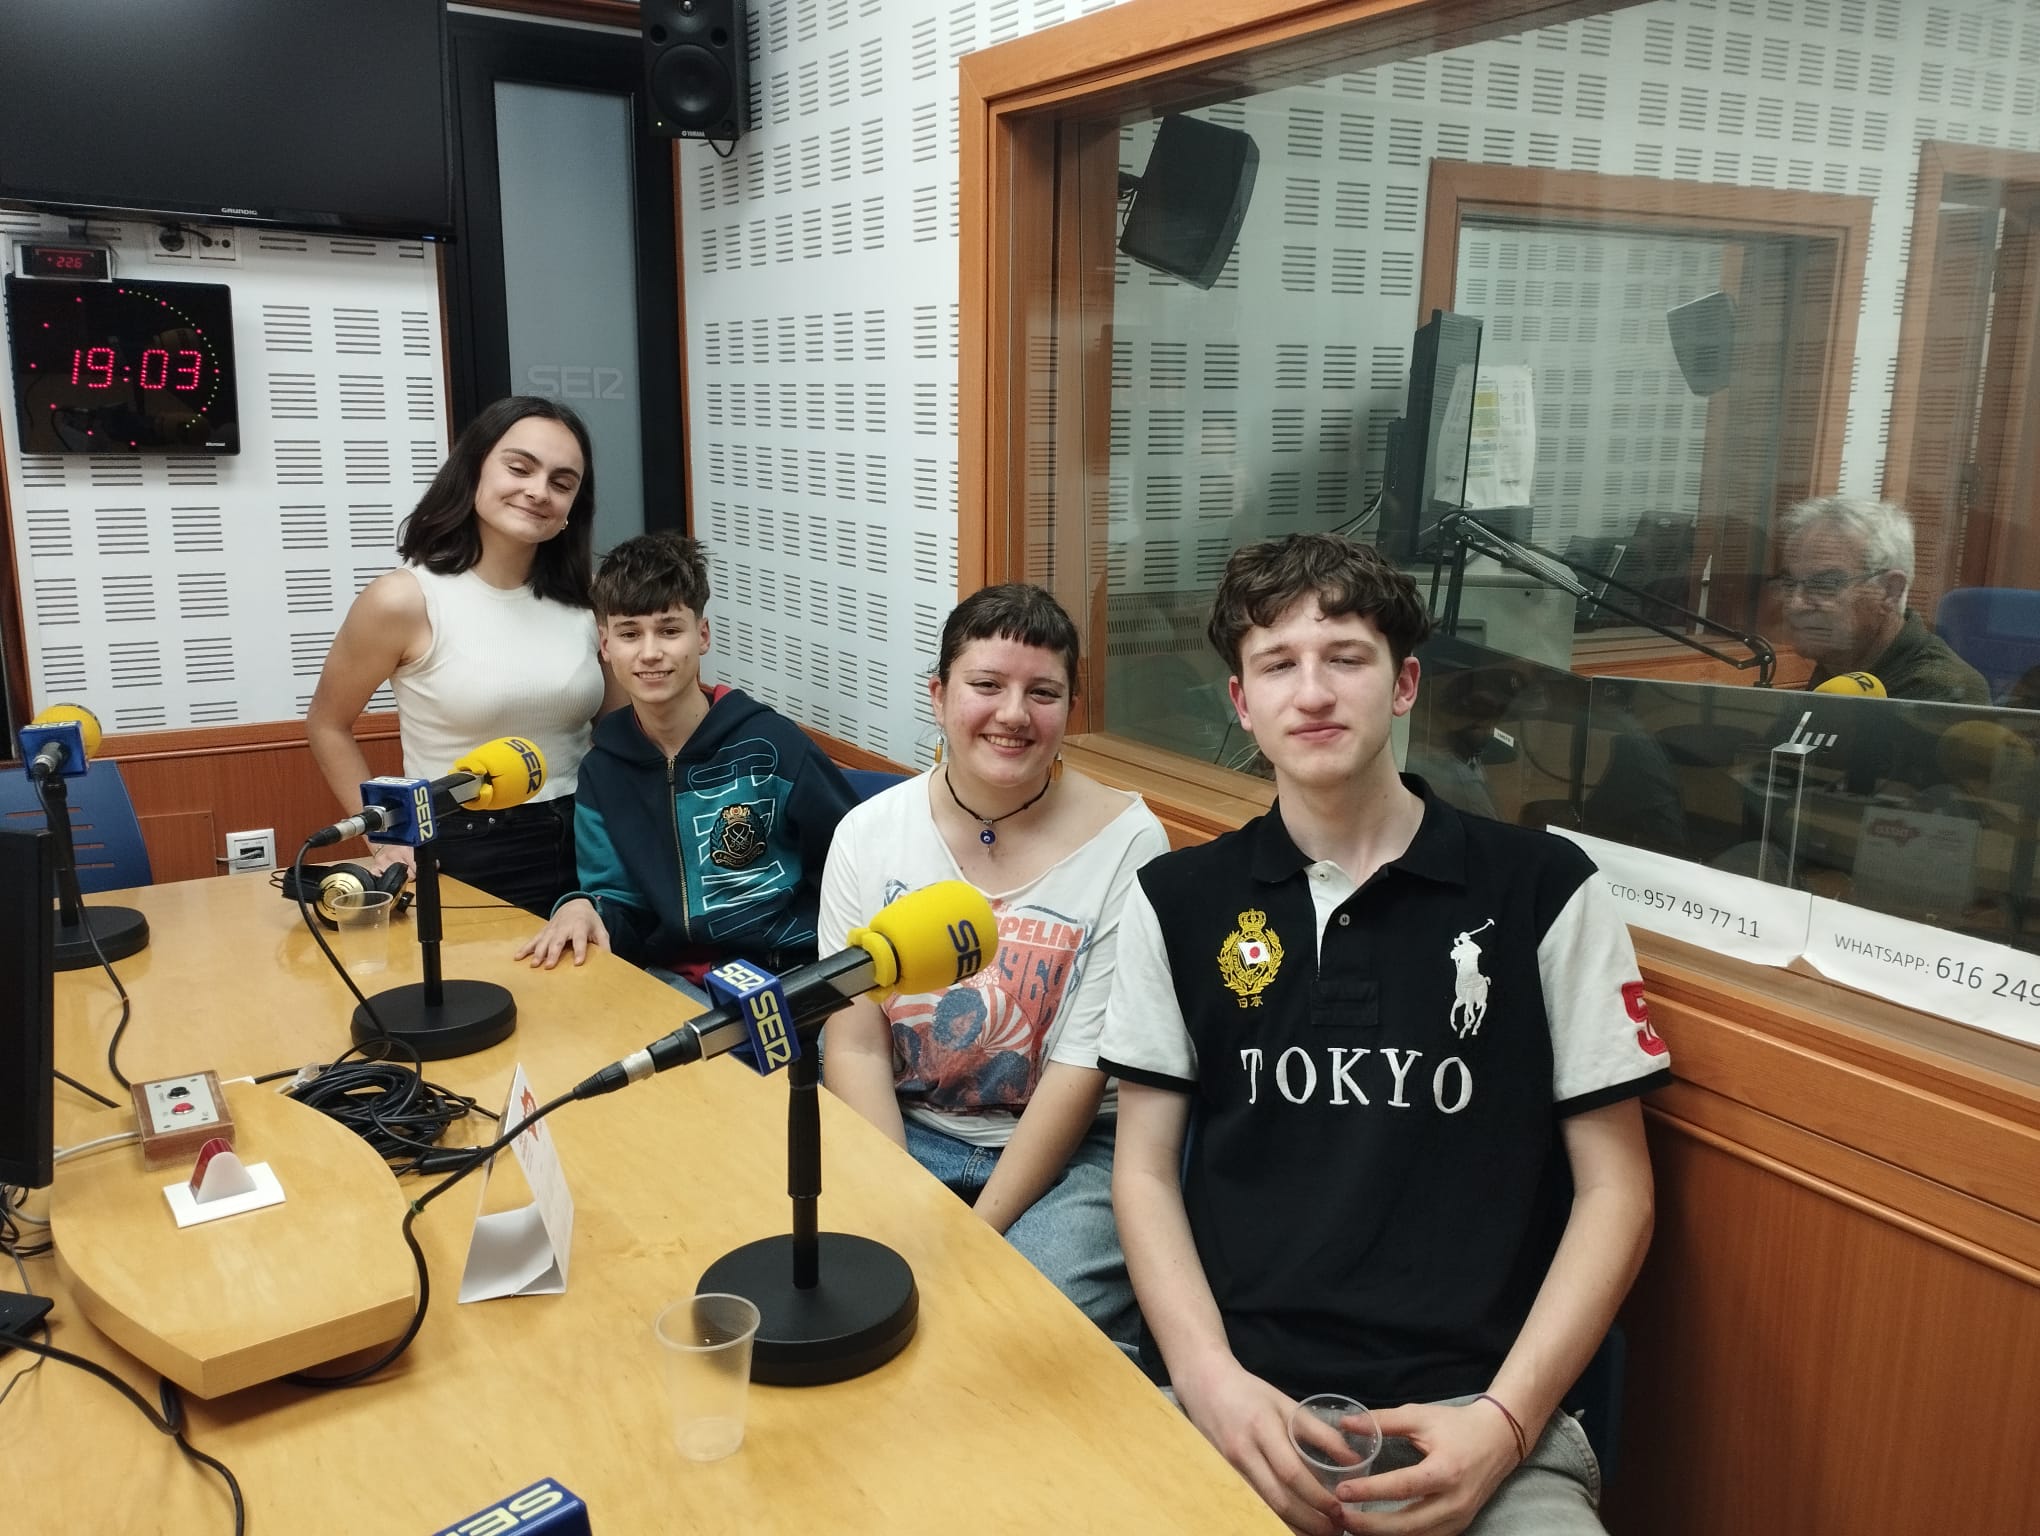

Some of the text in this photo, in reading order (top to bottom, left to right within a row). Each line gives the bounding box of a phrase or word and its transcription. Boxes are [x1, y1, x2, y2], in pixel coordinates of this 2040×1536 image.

[72, 347, 202, 390] 19:03
[527, 364, 625, 400] SER
[505, 739, 543, 795] SER
[413, 786, 434, 843] SER
[998, 915, 1084, 950] PELIN
[1644, 889, 1676, 911] 957
[1682, 900, 1704, 920] 49
[1709, 907, 1731, 928] 77
[1737, 917, 1761, 939] 11
[712, 962, 765, 992] SER
[946, 919, 982, 986] SE
[1834, 933, 1930, 974] WHATSAPP:
[1936, 956, 1984, 989] 616
[1237, 994, 1264, 1008] 日本
[750, 990, 791, 1069] SER
[1240, 1046, 1473, 1114] TOKYO
[445, 1483, 563, 1536] SE
